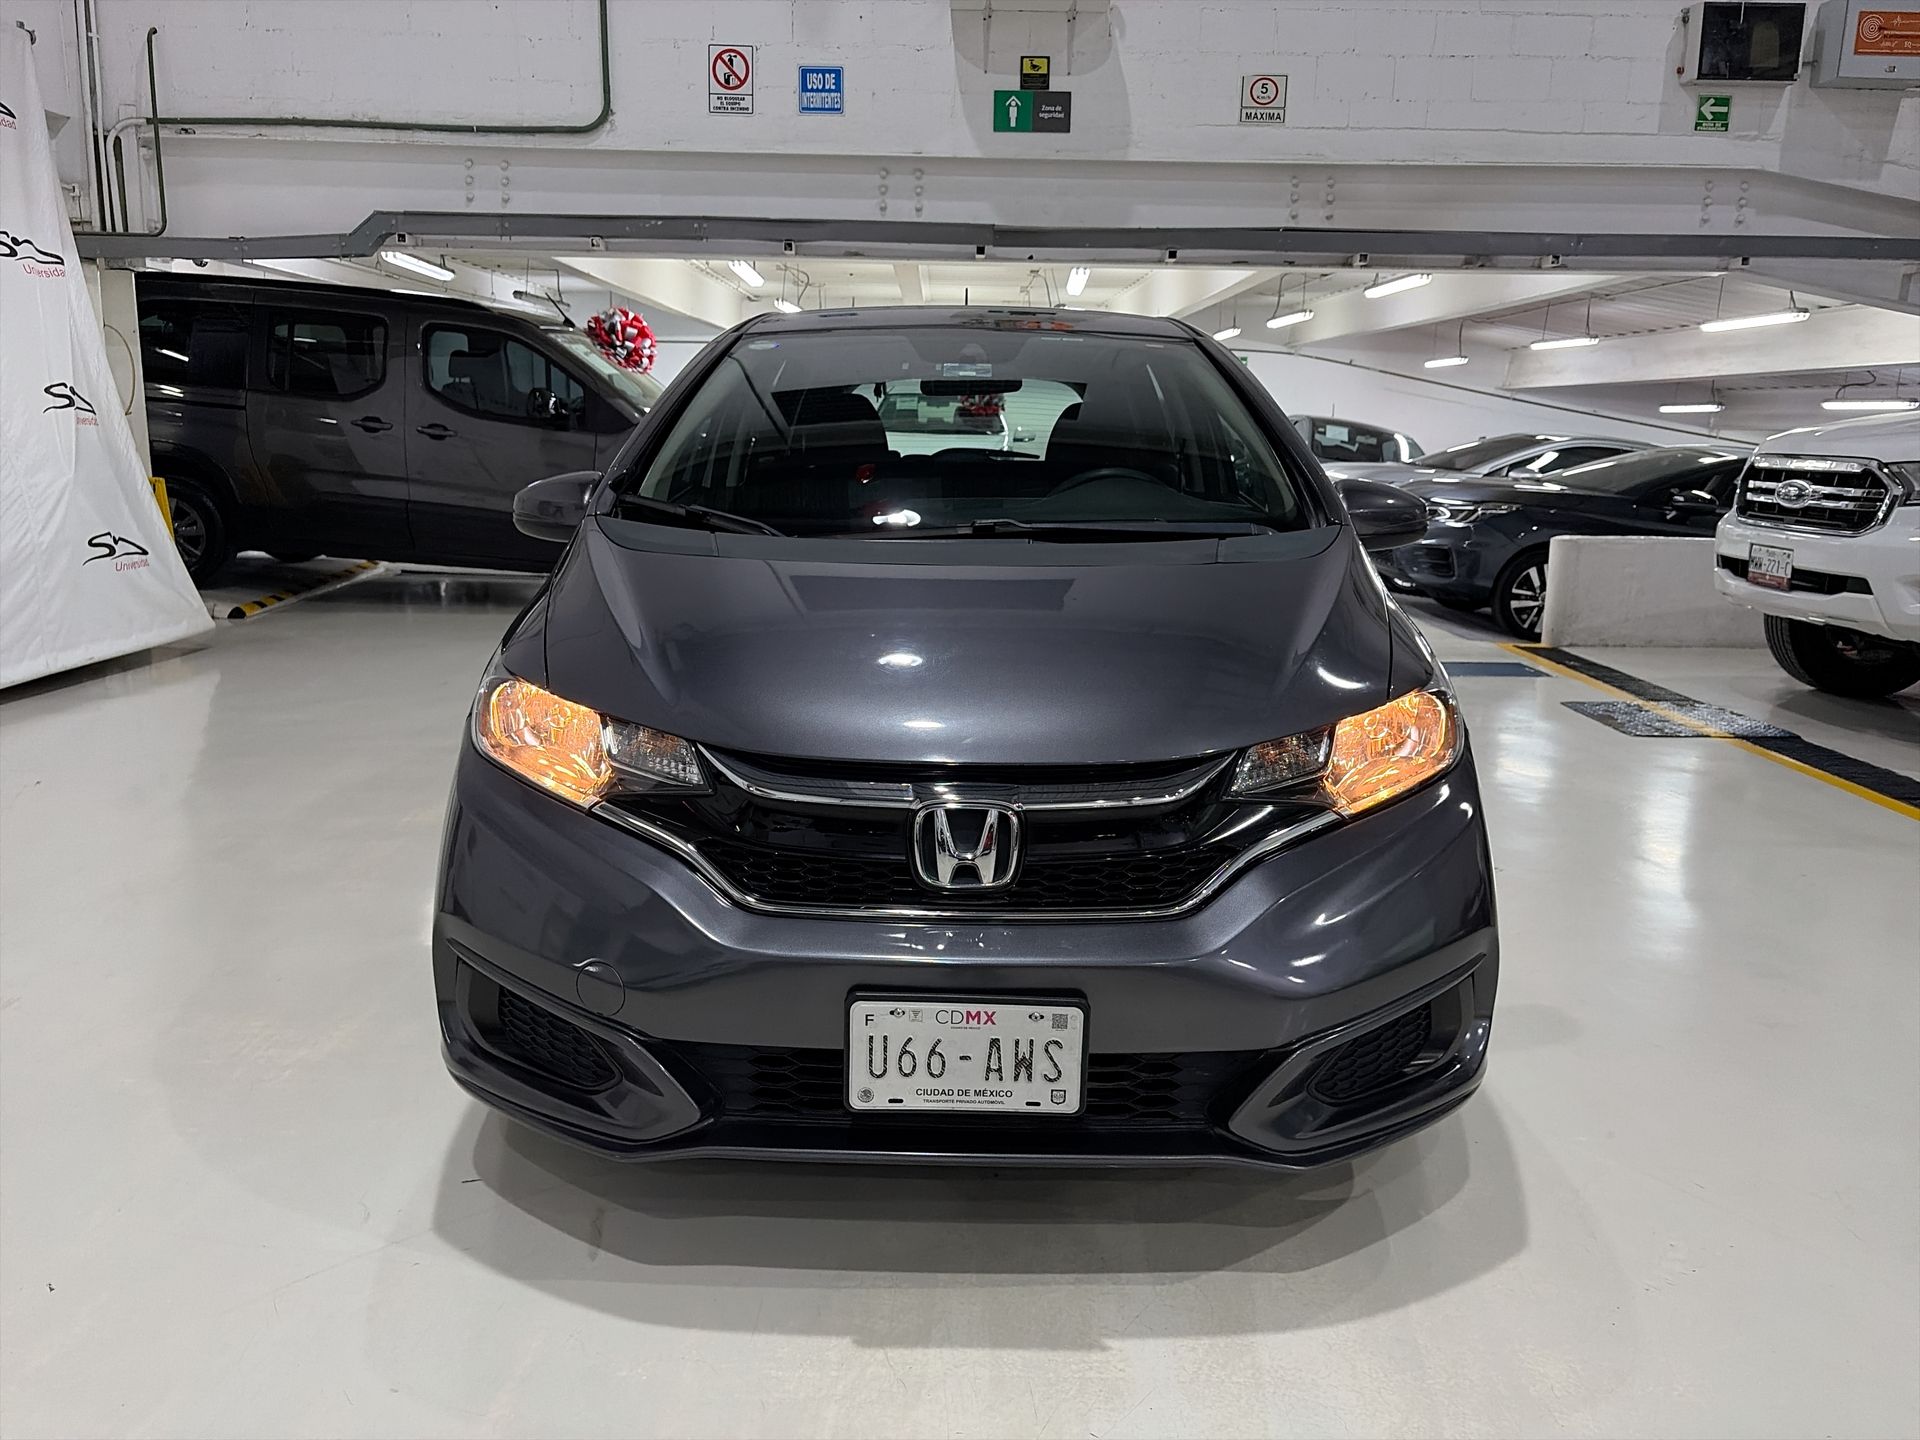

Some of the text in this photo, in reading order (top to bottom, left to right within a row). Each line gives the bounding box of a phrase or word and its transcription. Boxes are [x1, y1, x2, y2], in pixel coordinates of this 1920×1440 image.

[807, 73, 836, 89] USO DE
[1260, 83, 1269, 95] 5
[865, 1014, 875, 1027] F
[936, 1010, 997, 1025] CDMX
[868, 1035, 1064, 1083] U66-AWS
[915, 1088, 1013, 1098] CIUDAD DE MÉXICO
